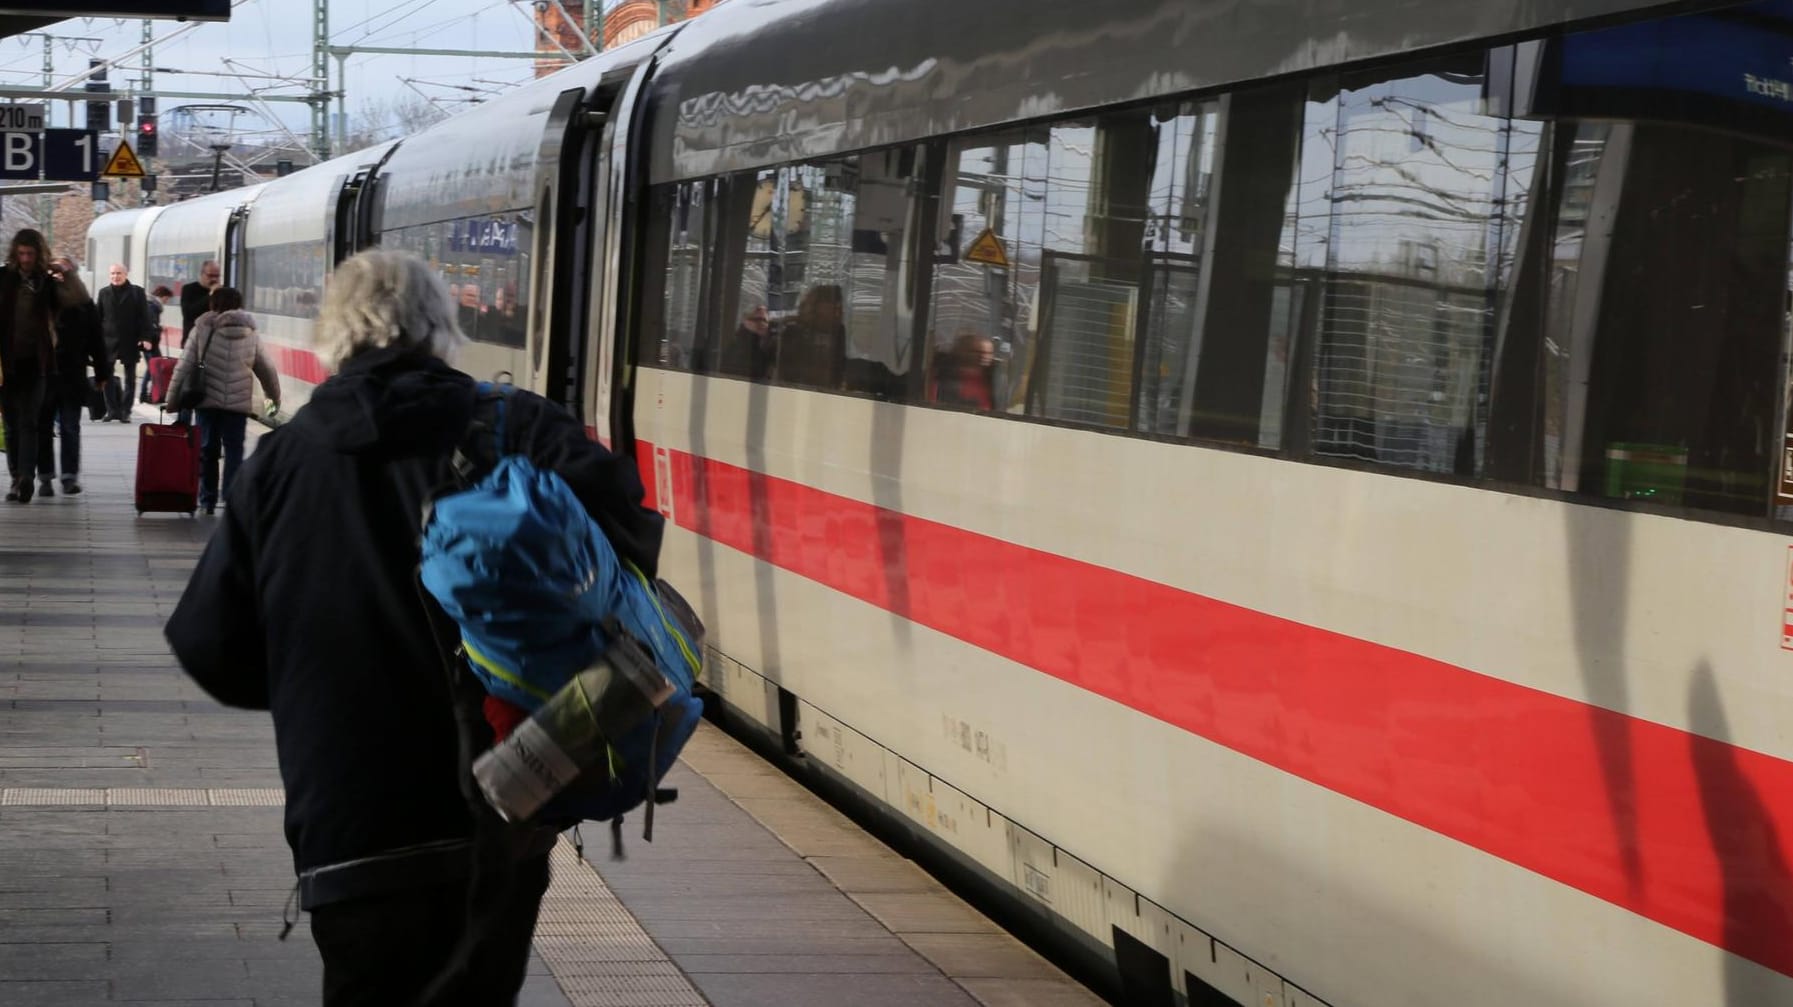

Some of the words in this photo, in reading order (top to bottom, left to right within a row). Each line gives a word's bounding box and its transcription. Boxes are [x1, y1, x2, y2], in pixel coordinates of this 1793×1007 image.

[0, 107, 25, 128] 210
[28, 115, 42, 129] m
[5, 132, 34, 171] B
[74, 134, 92, 172] 1
